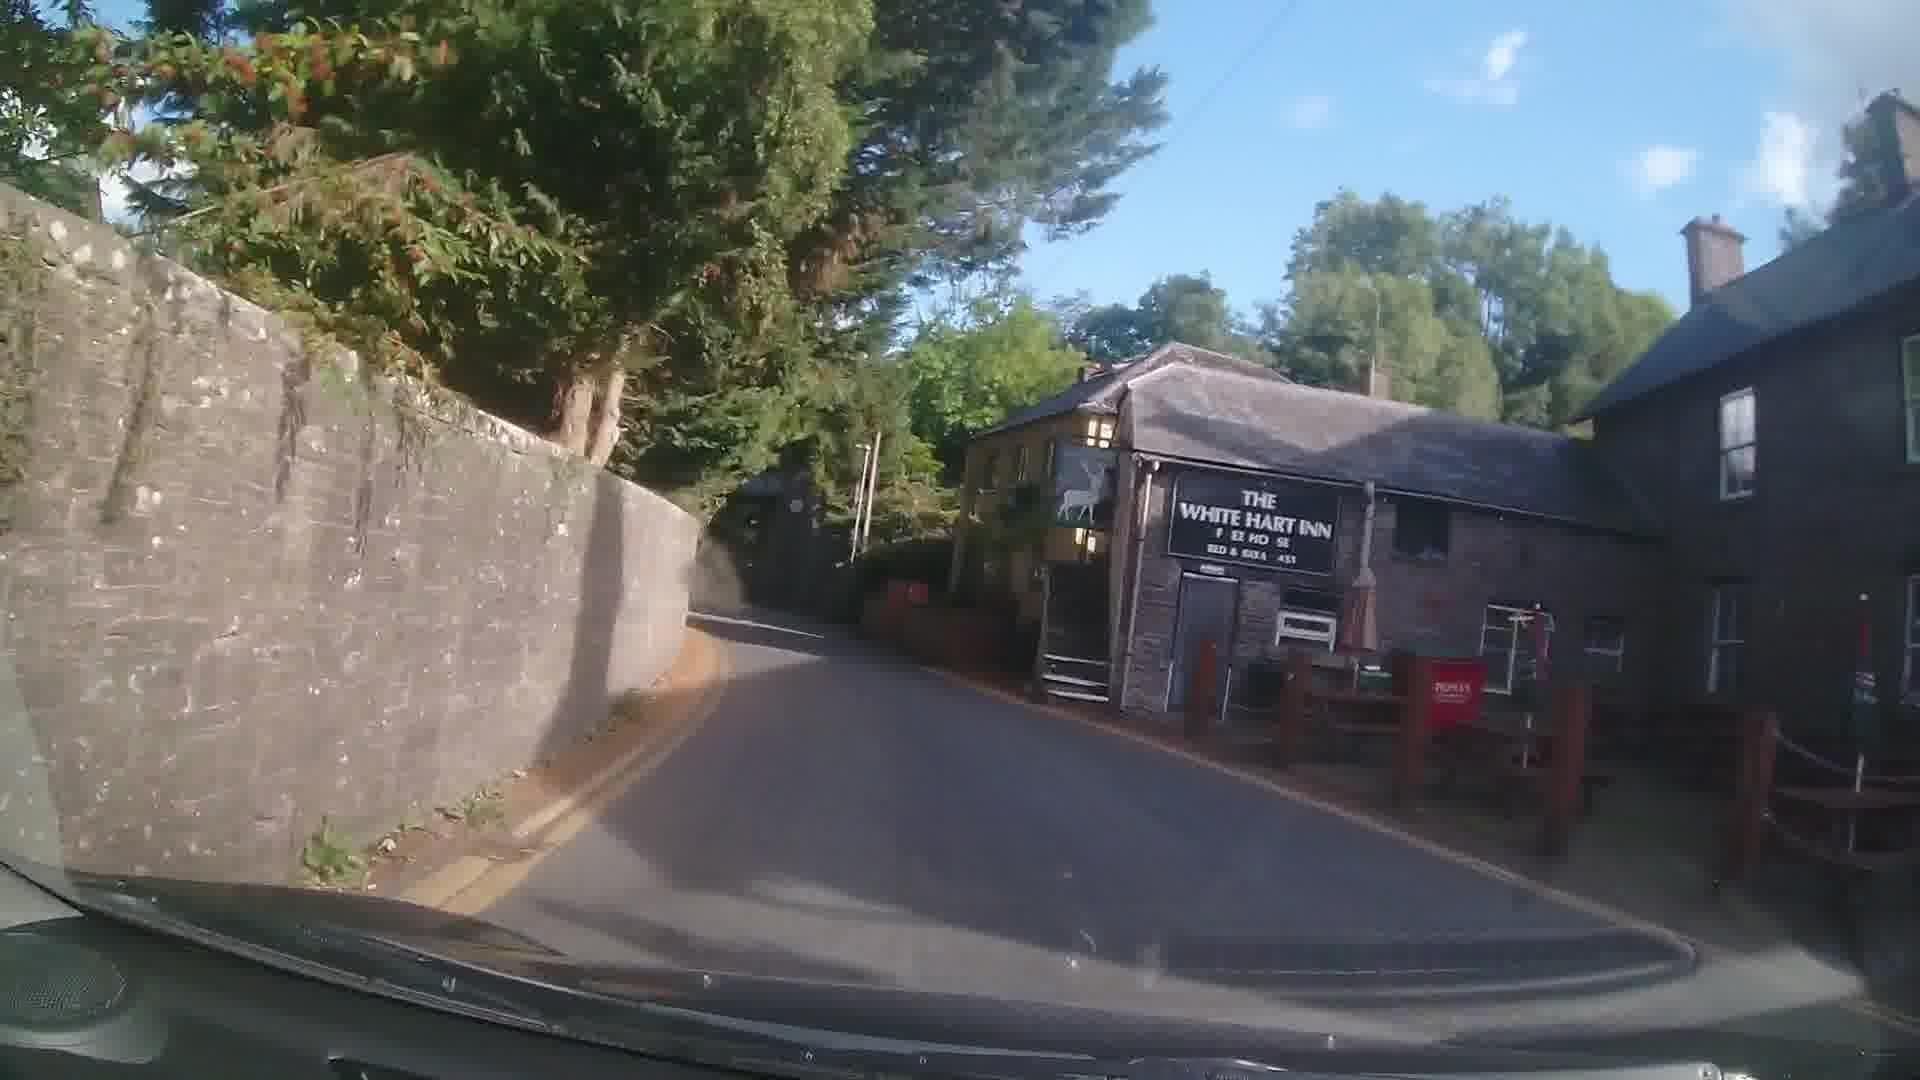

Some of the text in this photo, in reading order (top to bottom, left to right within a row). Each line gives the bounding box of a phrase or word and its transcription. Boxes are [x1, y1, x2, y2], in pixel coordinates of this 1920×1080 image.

[1242, 490, 1277, 509] THE
[1180, 501, 1333, 539] WHITE HART INN
